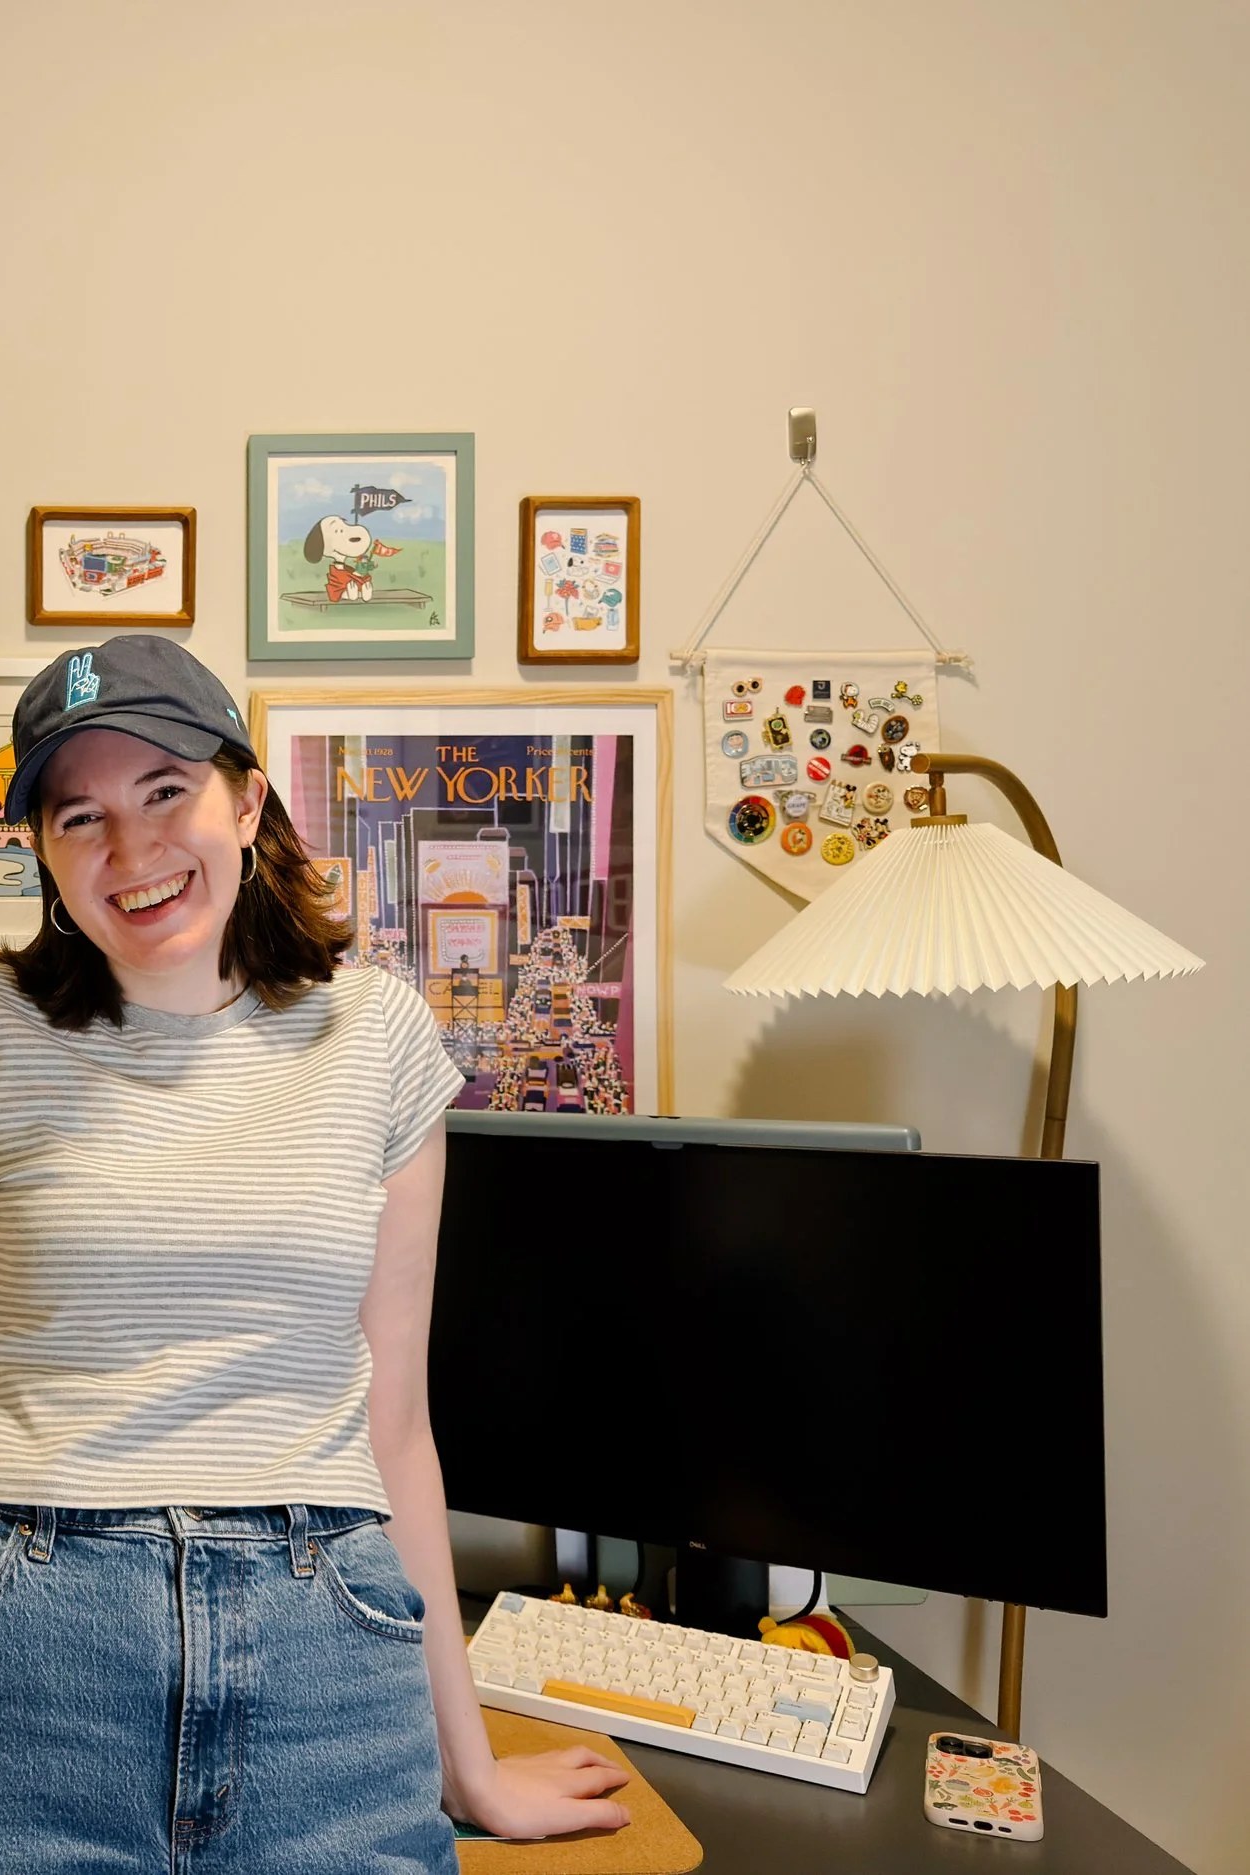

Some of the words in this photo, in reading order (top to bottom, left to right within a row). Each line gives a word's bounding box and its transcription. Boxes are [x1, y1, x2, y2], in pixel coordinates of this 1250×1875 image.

[360, 492, 397, 509] PHILS
[436, 745, 479, 763] THE
[336, 766, 430, 802] NEW
[436, 765, 596, 803] YORKER
